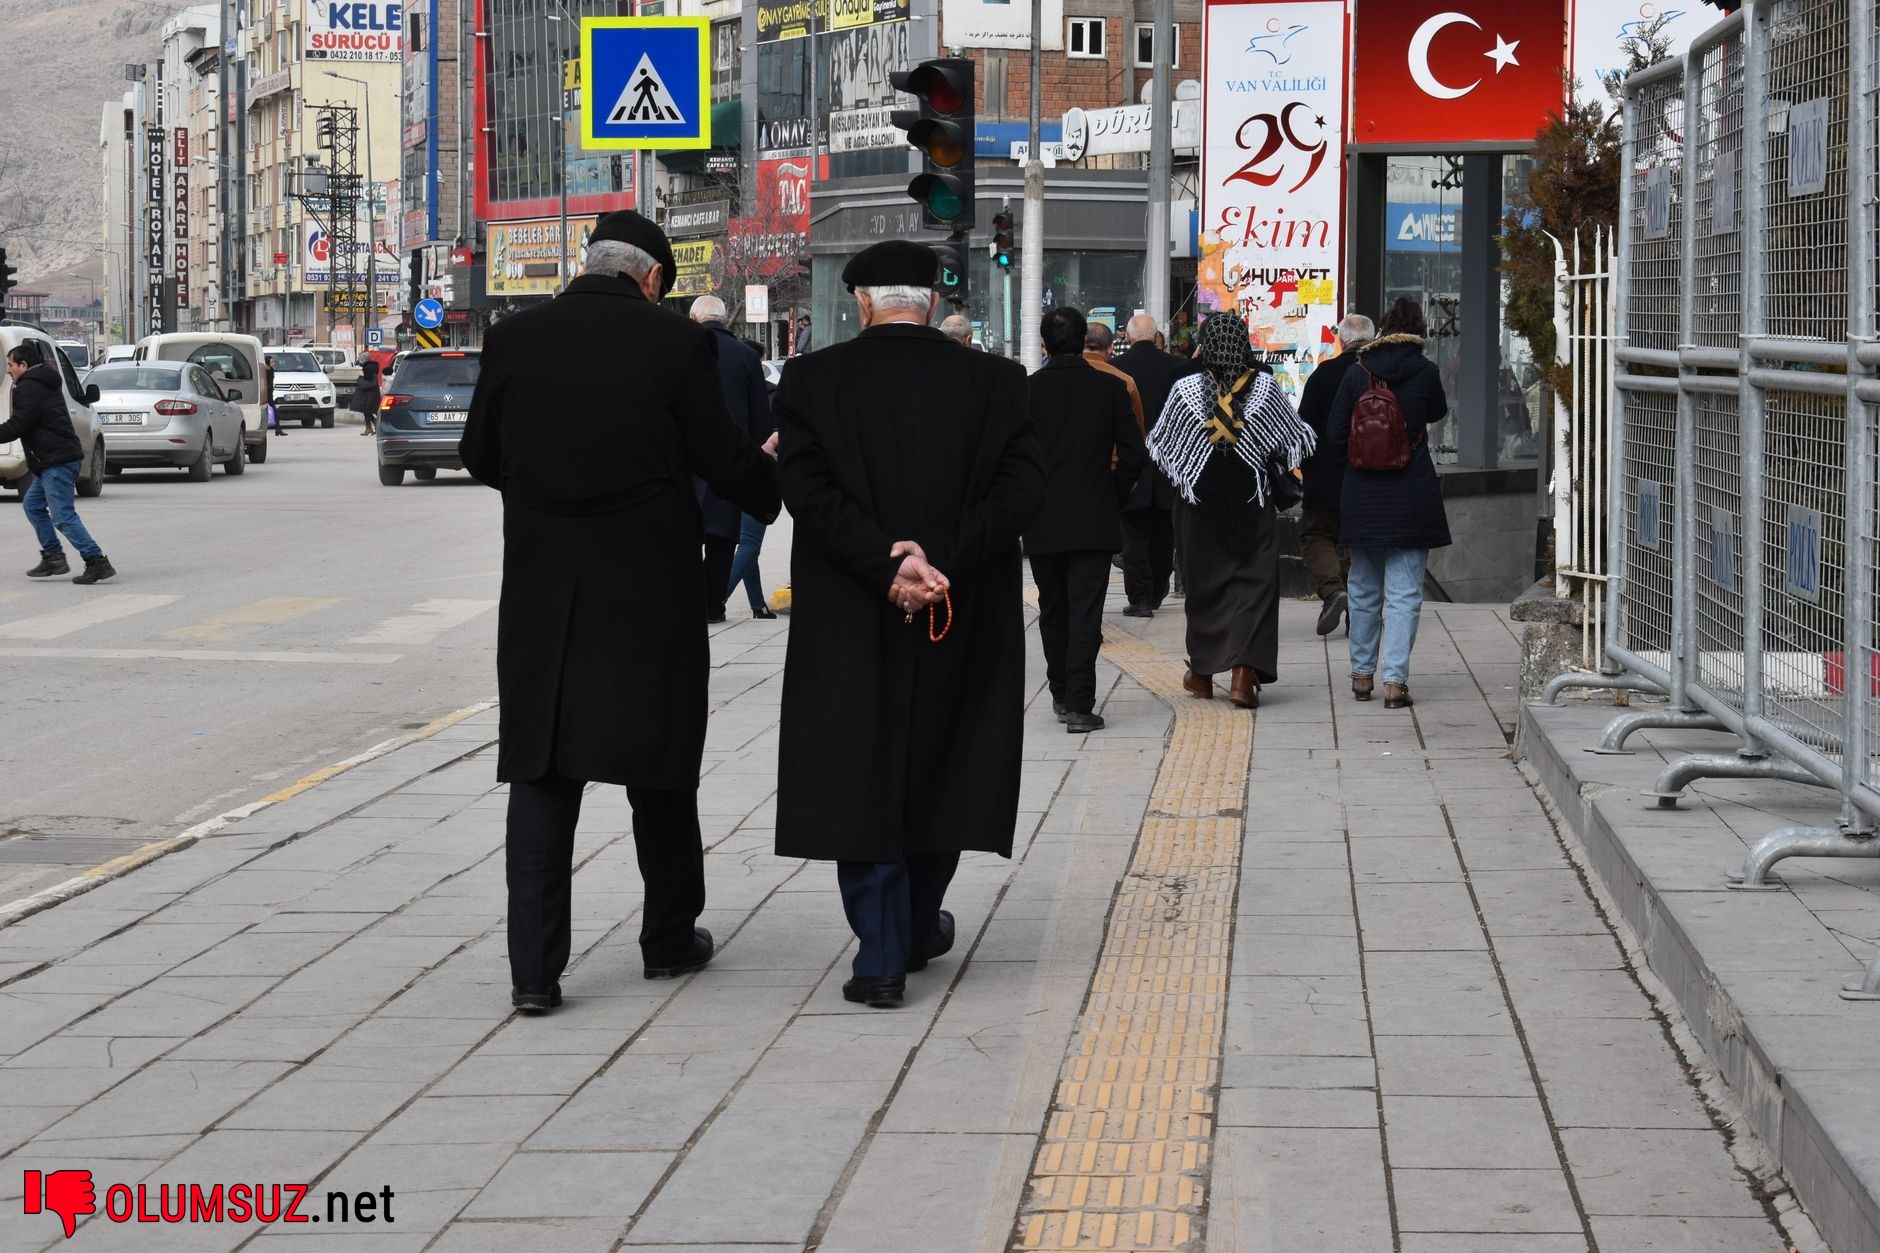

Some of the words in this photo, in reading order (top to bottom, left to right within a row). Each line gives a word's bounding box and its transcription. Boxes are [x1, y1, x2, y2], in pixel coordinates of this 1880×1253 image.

[311, 31, 391, 50] SÜRÜCÜ
[330, 50, 348, 60] 0432
[349, 50, 362, 60] 210
[364, 51, 373, 60] 18
[375, 51, 383, 60] 17
[1226, 80, 1258, 92] VAN
[1262, 76, 1327, 92] VALİLİĞİ
[770, 117, 807, 149] ONAY
[1222, 101, 1327, 193] 29
[150, 142, 162, 200] HOTEL
[175, 176, 187, 236] APART
[1216, 205, 1331, 249] Ekim
[151, 208, 162, 266] ROYAL
[508, 226, 543, 244] BEBELER
[544, 223, 576, 243] SARYI
[176, 246, 187, 307] HOTEL
[371, 332, 378, 342] D
[1788, 514, 1818, 594] POLİS
